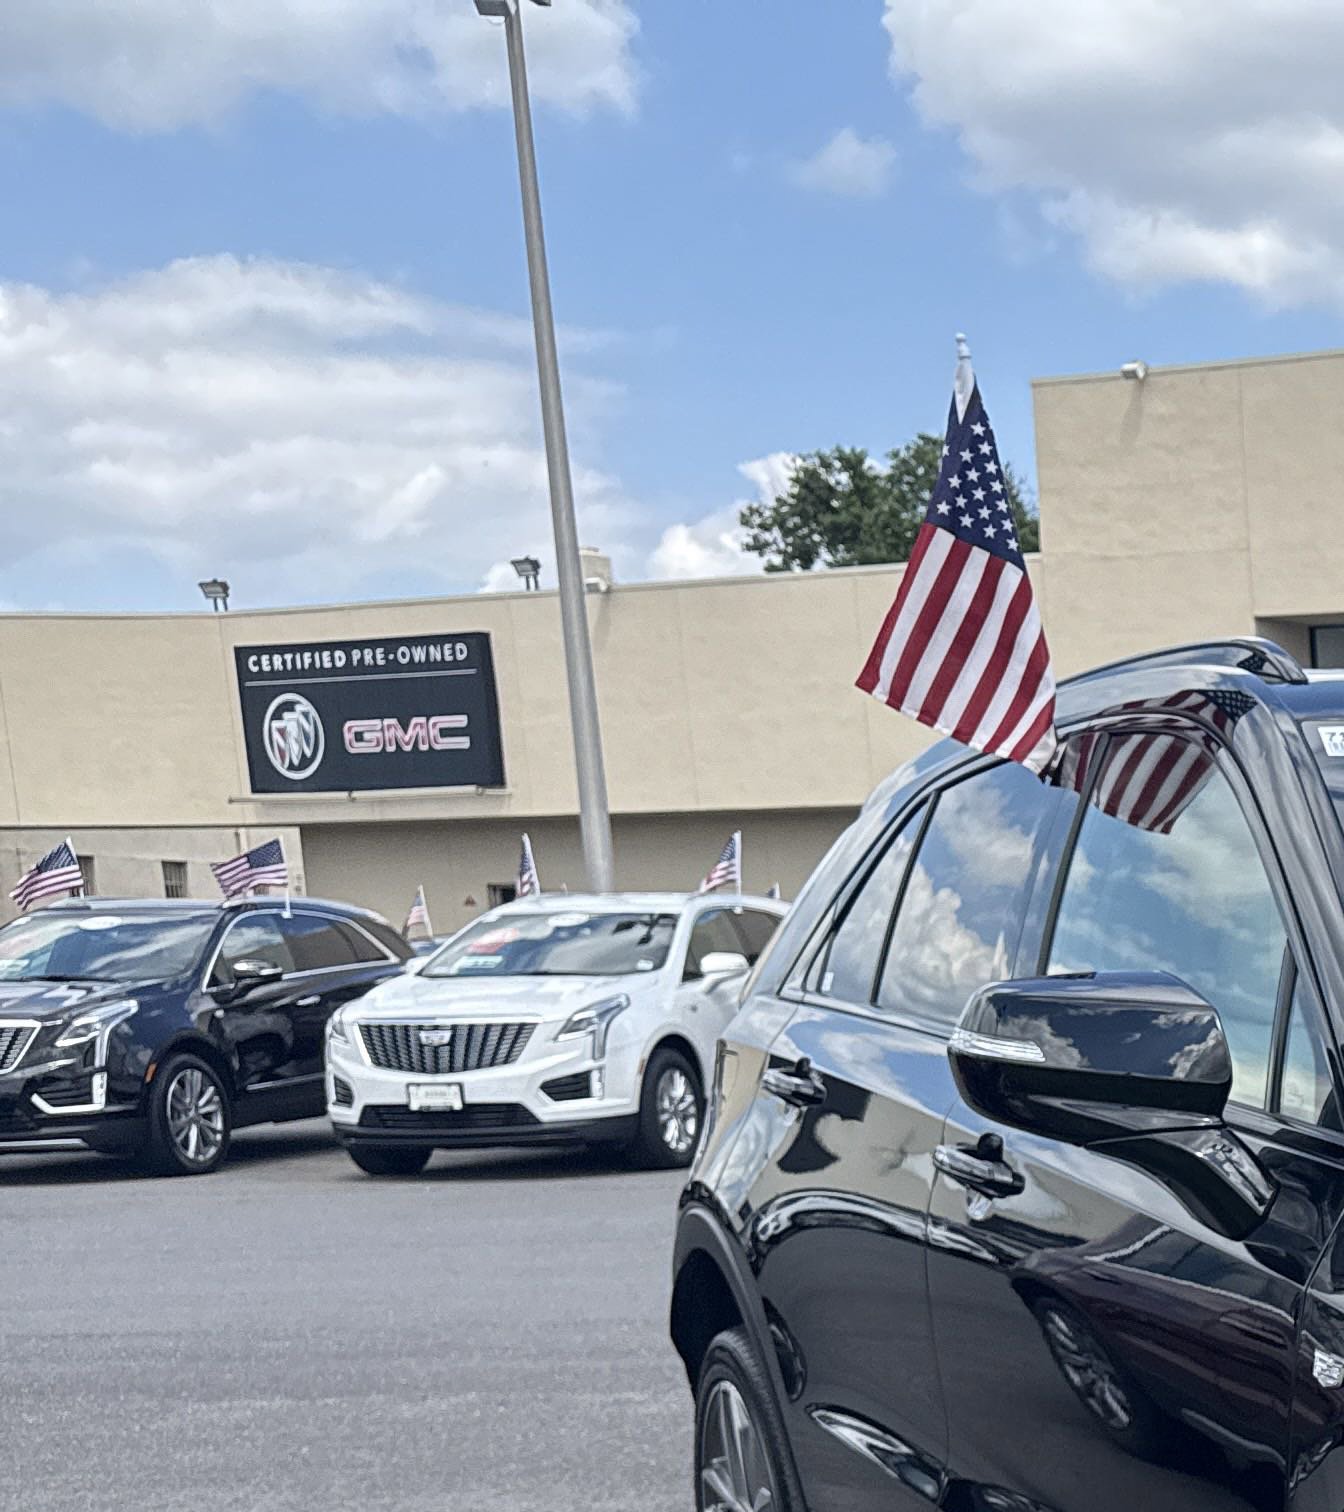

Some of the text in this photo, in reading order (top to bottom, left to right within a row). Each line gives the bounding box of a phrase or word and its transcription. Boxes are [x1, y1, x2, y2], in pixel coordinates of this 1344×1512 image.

[248, 642, 468, 673] CERTIFIED PRE-OWNED
[343, 714, 471, 754] GMC
